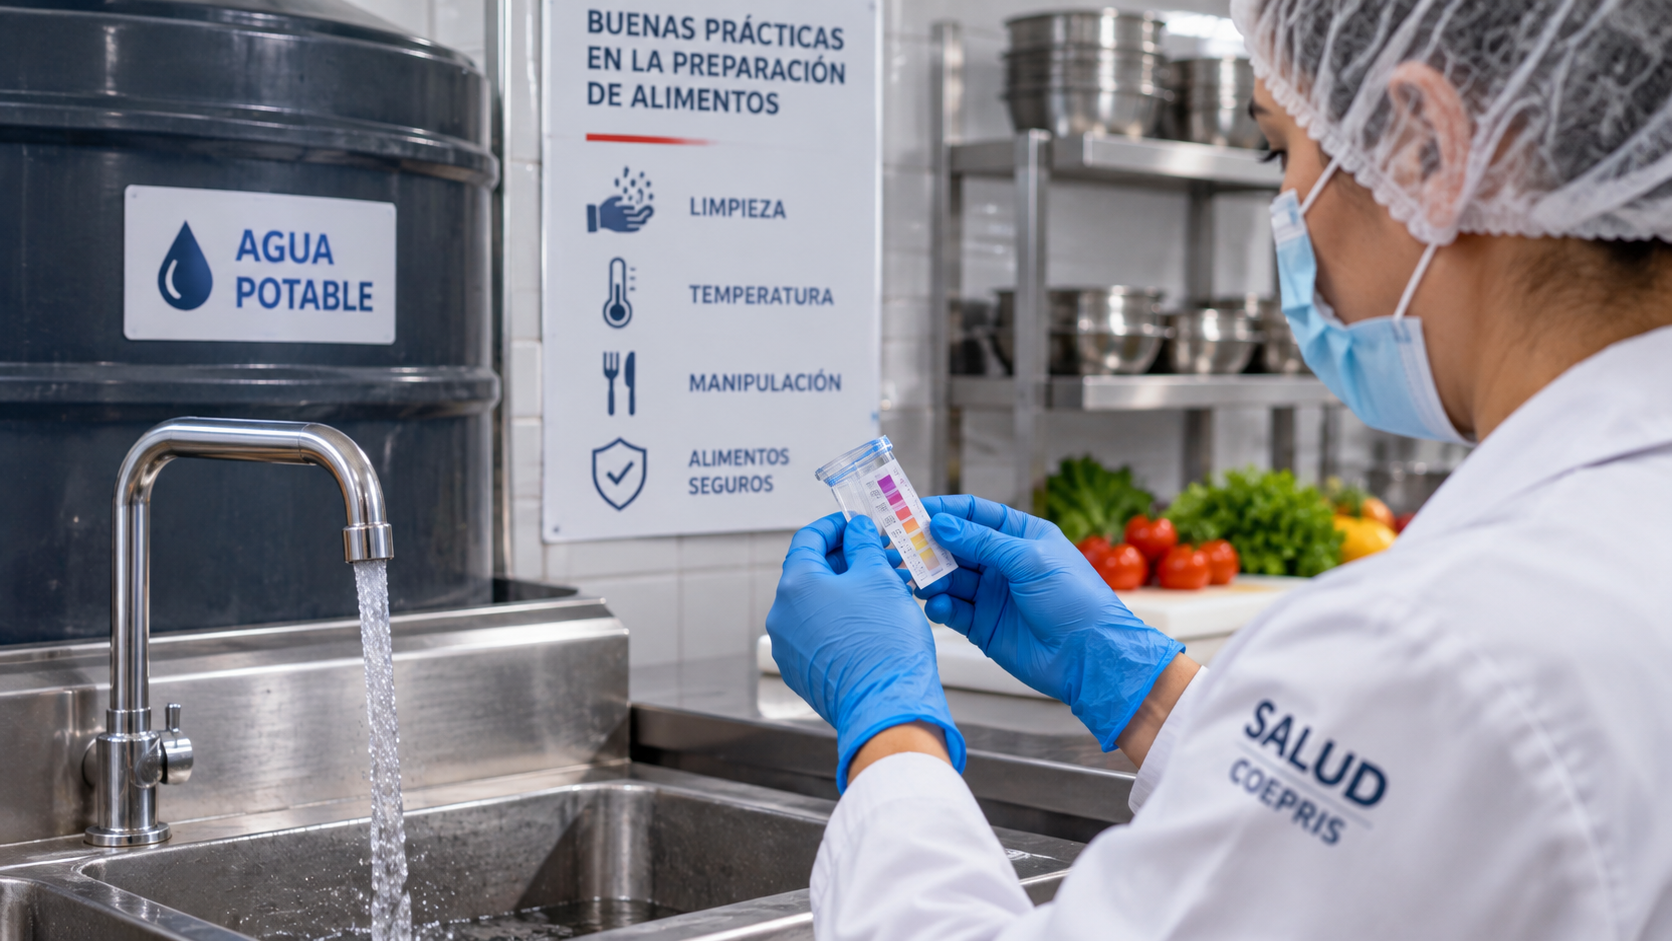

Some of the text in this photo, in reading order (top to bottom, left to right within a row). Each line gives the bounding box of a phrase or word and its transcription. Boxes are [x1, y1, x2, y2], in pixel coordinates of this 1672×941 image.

[587, 9, 845, 51] BUENAS PRÁCTICAS
[587, 45, 846, 85] EN LA PREPARACIÓN
[587, 81, 780, 116] DE ALIMENTOS
[689, 196, 787, 219] LIMPIEZA
[235, 228, 335, 266] AGUA
[236, 276, 374, 313] POTABLE
[688, 284, 834, 306] TEMPERATURA
[689, 369, 842, 393] MANIPULACIÓN
[688, 447, 790, 468] ALIMENTOS
[688, 474, 774, 496] SEGUROS
[1244, 699, 1388, 809] SALUD
[1229, 757, 1346, 846] COEPRIS
